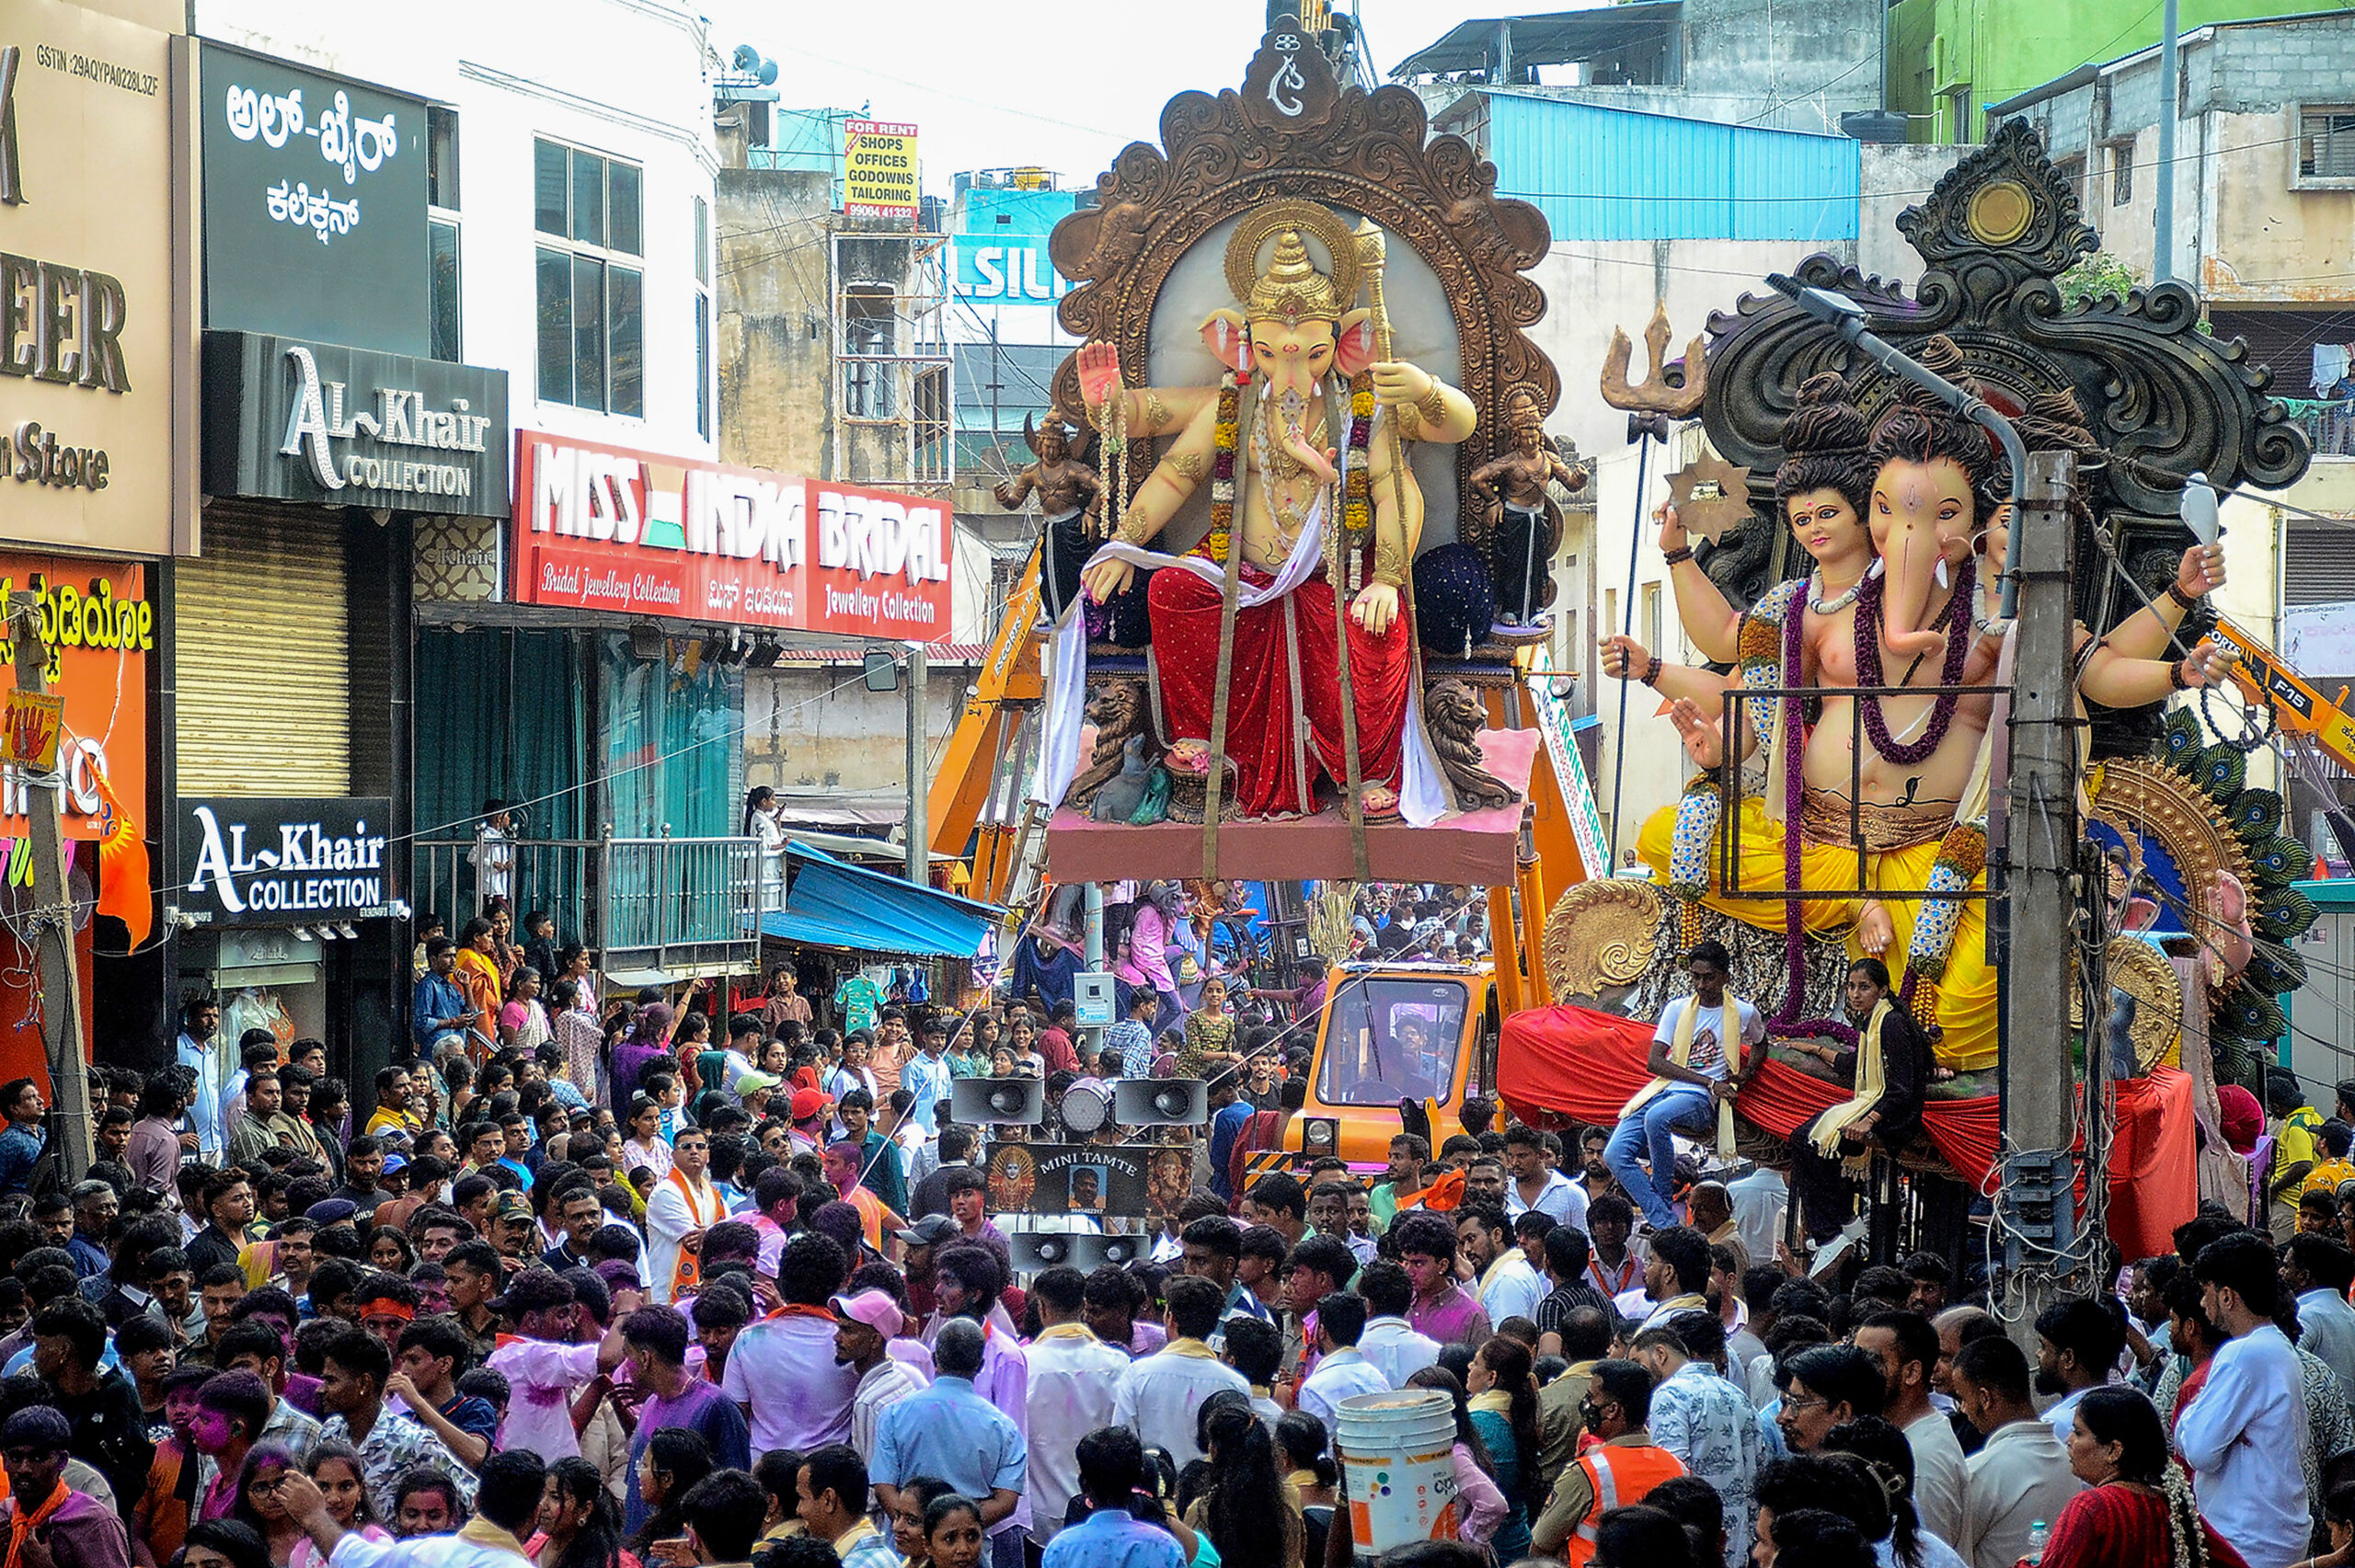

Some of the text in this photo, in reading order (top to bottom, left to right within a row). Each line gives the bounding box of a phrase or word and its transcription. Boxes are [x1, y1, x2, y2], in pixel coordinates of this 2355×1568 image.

[37, 44, 66, 72] GSTIN
[846, 121, 916, 136] FOR RENT
[860, 136, 903, 150] SHOPS
[856, 153, 908, 167] OFFICES
[849, 169, 913, 185] GODOWNS
[851, 186, 912, 201] TAILORING
[16, 422, 109, 490] Store
[343, 455, 470, 497] COLLECTION
[532, 442, 948, 586] MISS INDIA BRIDAL
[542, 562, 680, 607] Bridal Jewellery Collection
[825, 584, 935, 624] Jewellery Collection
[2274, 680, 2306, 707] F15
[1558, 707, 1585, 793] CRANE
[248, 877, 380, 911] COLLECTION
[1040, 1152, 1138, 1177] MINI TAMTE
